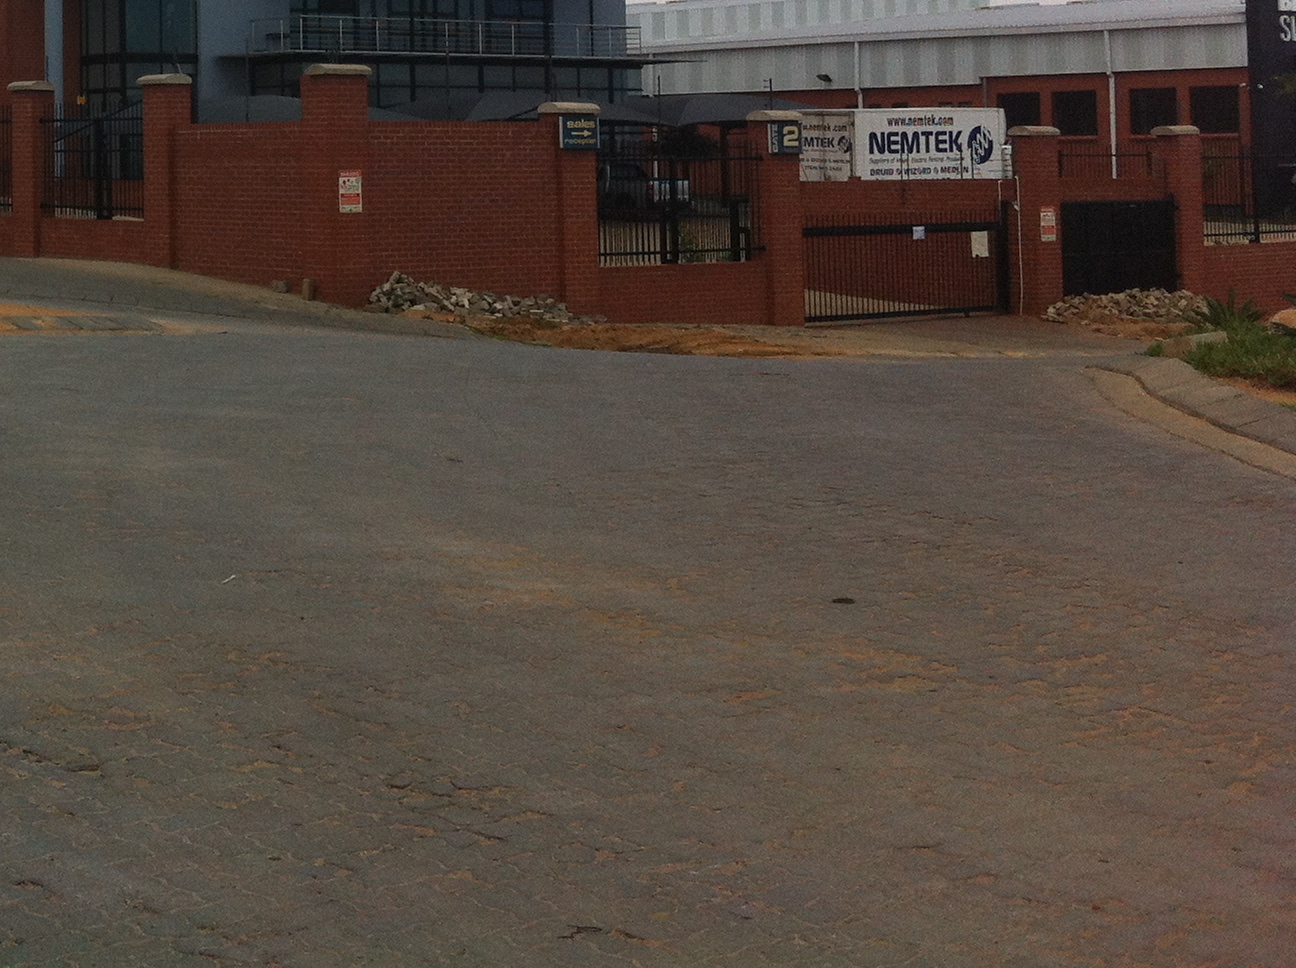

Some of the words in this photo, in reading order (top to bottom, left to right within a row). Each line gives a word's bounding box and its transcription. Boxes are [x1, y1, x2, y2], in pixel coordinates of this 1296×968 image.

[566, 118, 596, 129] sales
[887, 115, 954, 127] www.nemtek.com
[782, 125, 800, 147] 2
[803, 136, 835, 148] MTEK
[869, 131, 963, 154] NEMTEK
[870, 168, 894, 176] DRUID
[940, 166, 969, 174] MERLN
